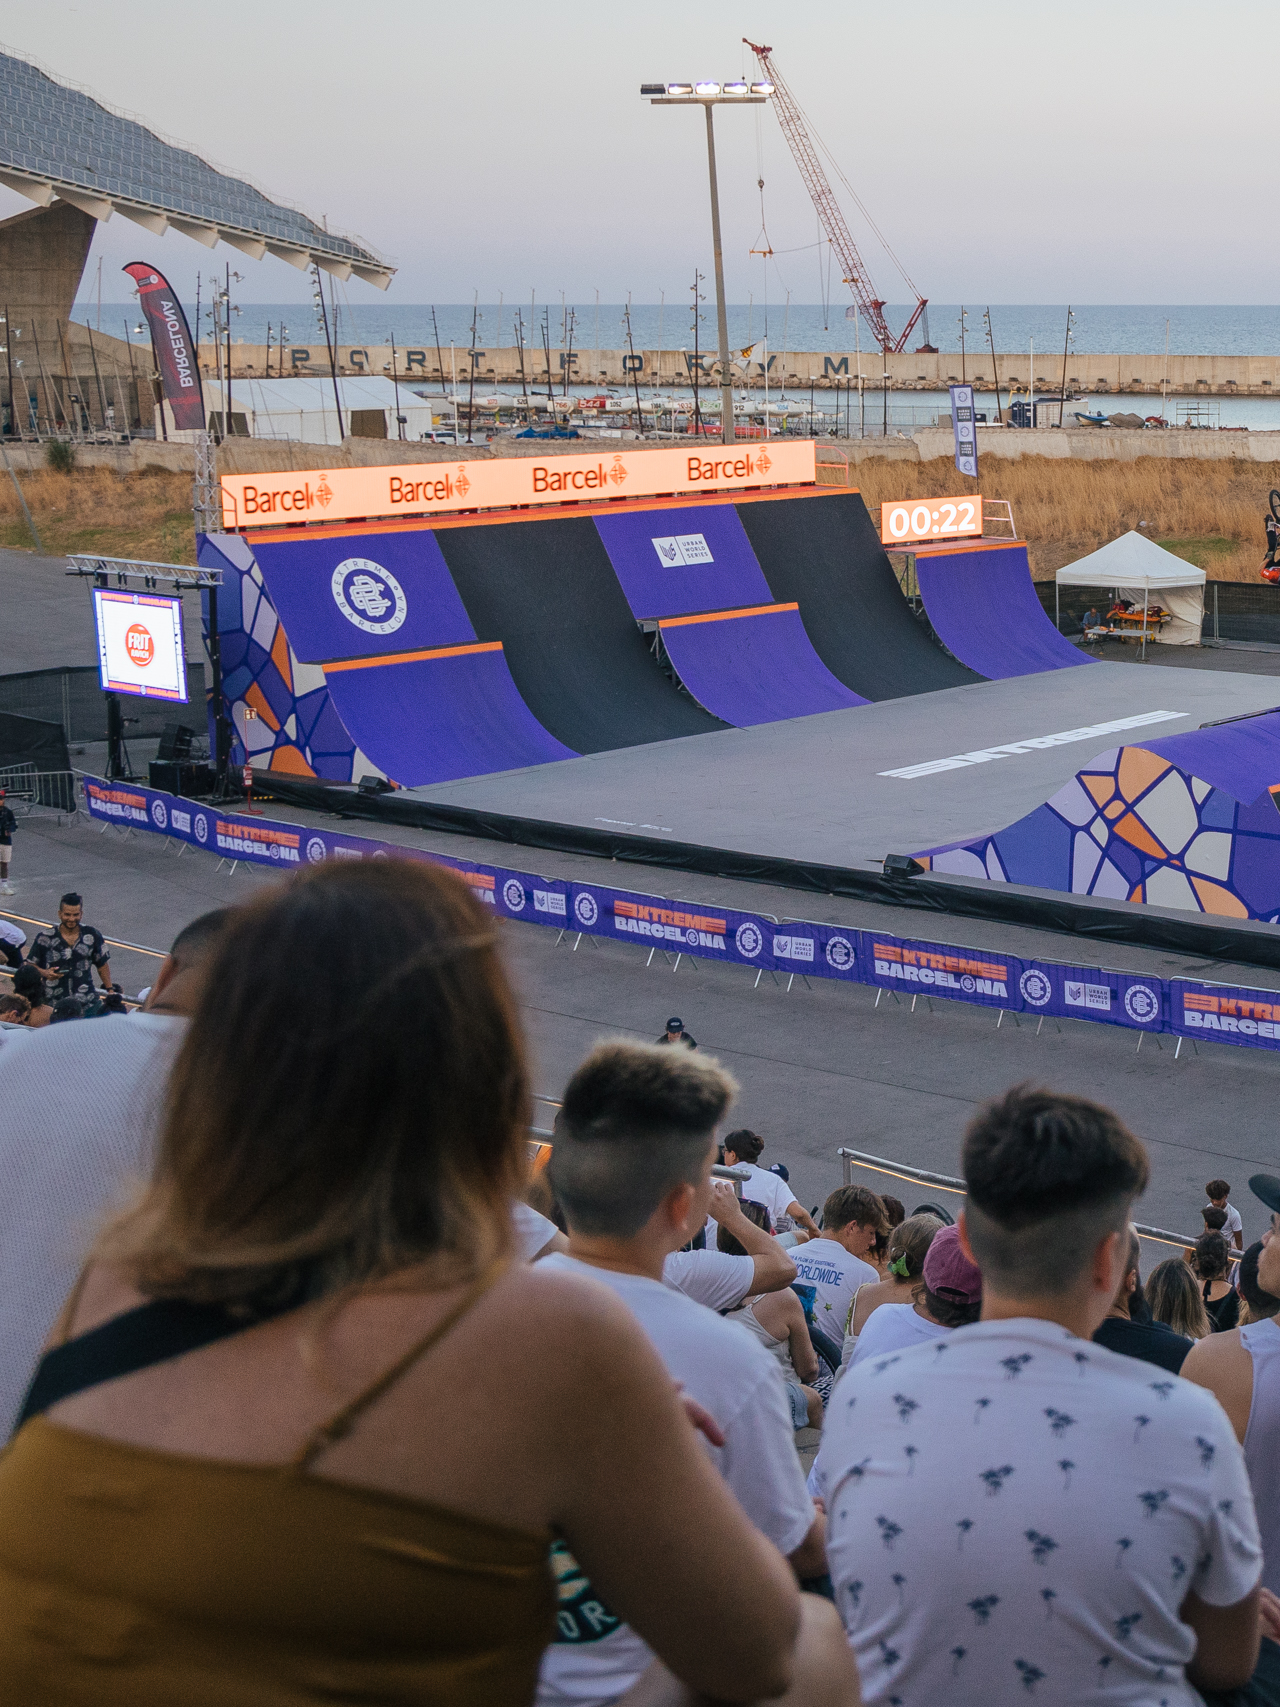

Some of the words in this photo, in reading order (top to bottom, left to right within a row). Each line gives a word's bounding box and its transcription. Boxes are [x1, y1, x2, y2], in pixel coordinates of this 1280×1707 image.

[291, 349, 486, 368] PORT
[579, 400, 601, 408] 544
[889, 502, 976, 538] 00:22
[334, 560, 391, 586] EXTREME
[339, 595, 405, 632] BARCELONA
[128, 632, 151, 651] FRIT
[876, 710, 1191, 779] EXTREME
[216, 820, 300, 848] EXTREME
[614, 900, 726, 934] EXTREME
[614, 916, 726, 950] BARCELONA
[874, 943, 1007, 981] EXTREME
[874, 960, 1008, 998] BARCELONA
[1088, 988, 1108, 996] URBAN
[1088, 993, 1108, 1001] WORLD
